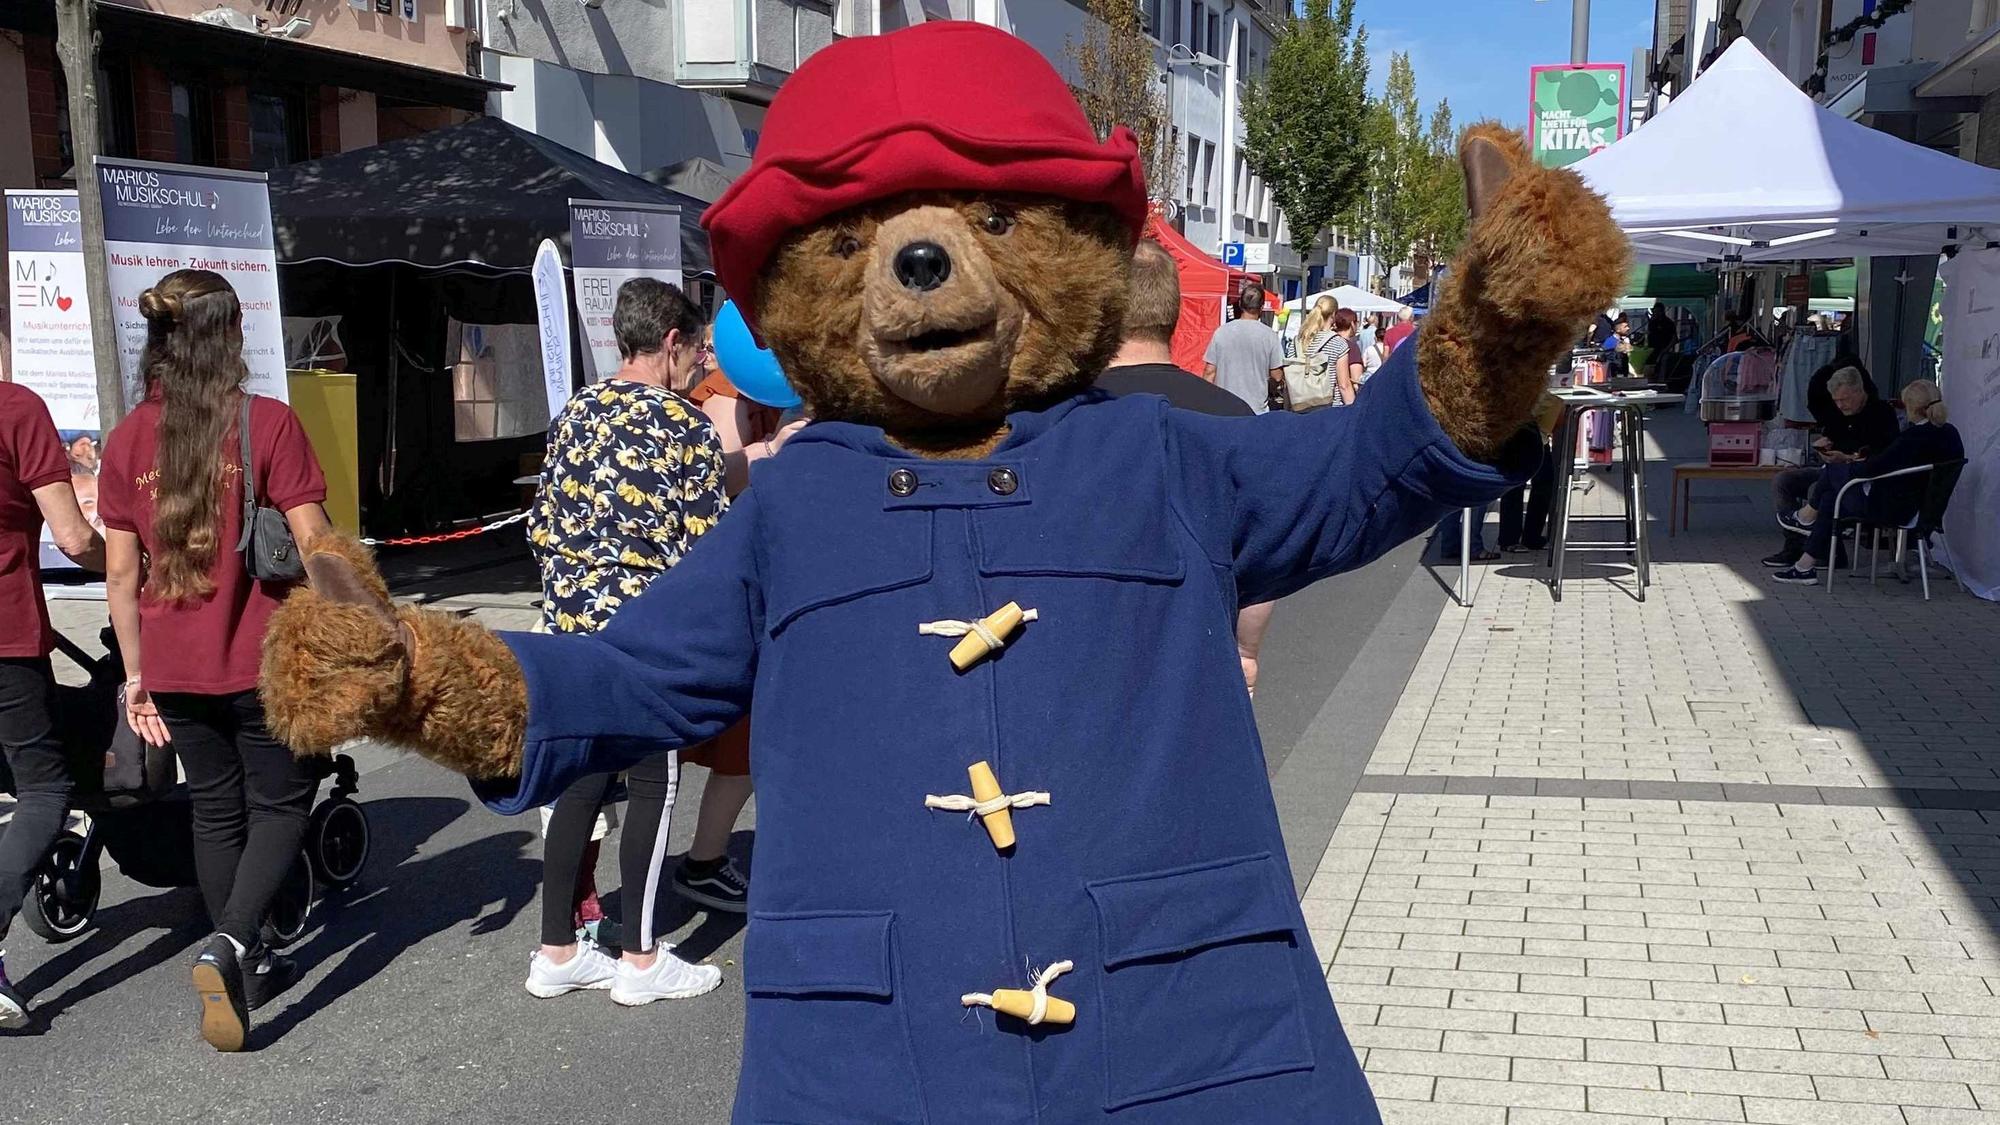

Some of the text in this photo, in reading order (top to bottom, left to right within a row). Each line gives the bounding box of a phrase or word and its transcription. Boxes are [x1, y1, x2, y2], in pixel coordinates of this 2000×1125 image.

[1541, 110, 1572, 120] MACHT
[1541, 116, 1587, 128] KNETE FÜR
[1540, 127, 1606, 150] KITAS
[102, 167, 160, 187] MARIOS
[12, 197, 61, 210] MARIOS
[574, 208, 611, 222] MARIOS
[155, 216, 178, 235] Lebe
[54, 231, 76, 246] Lebe
[111, 253, 142, 268] Musik
[145, 255, 180, 268] lehren
[188, 257, 229, 271] Zukunft
[230, 260, 271, 273] sichern.
[1225, 245, 1239, 264] P
[582, 278, 612, 297] FREI
[584, 297, 613, 311] RAUM
